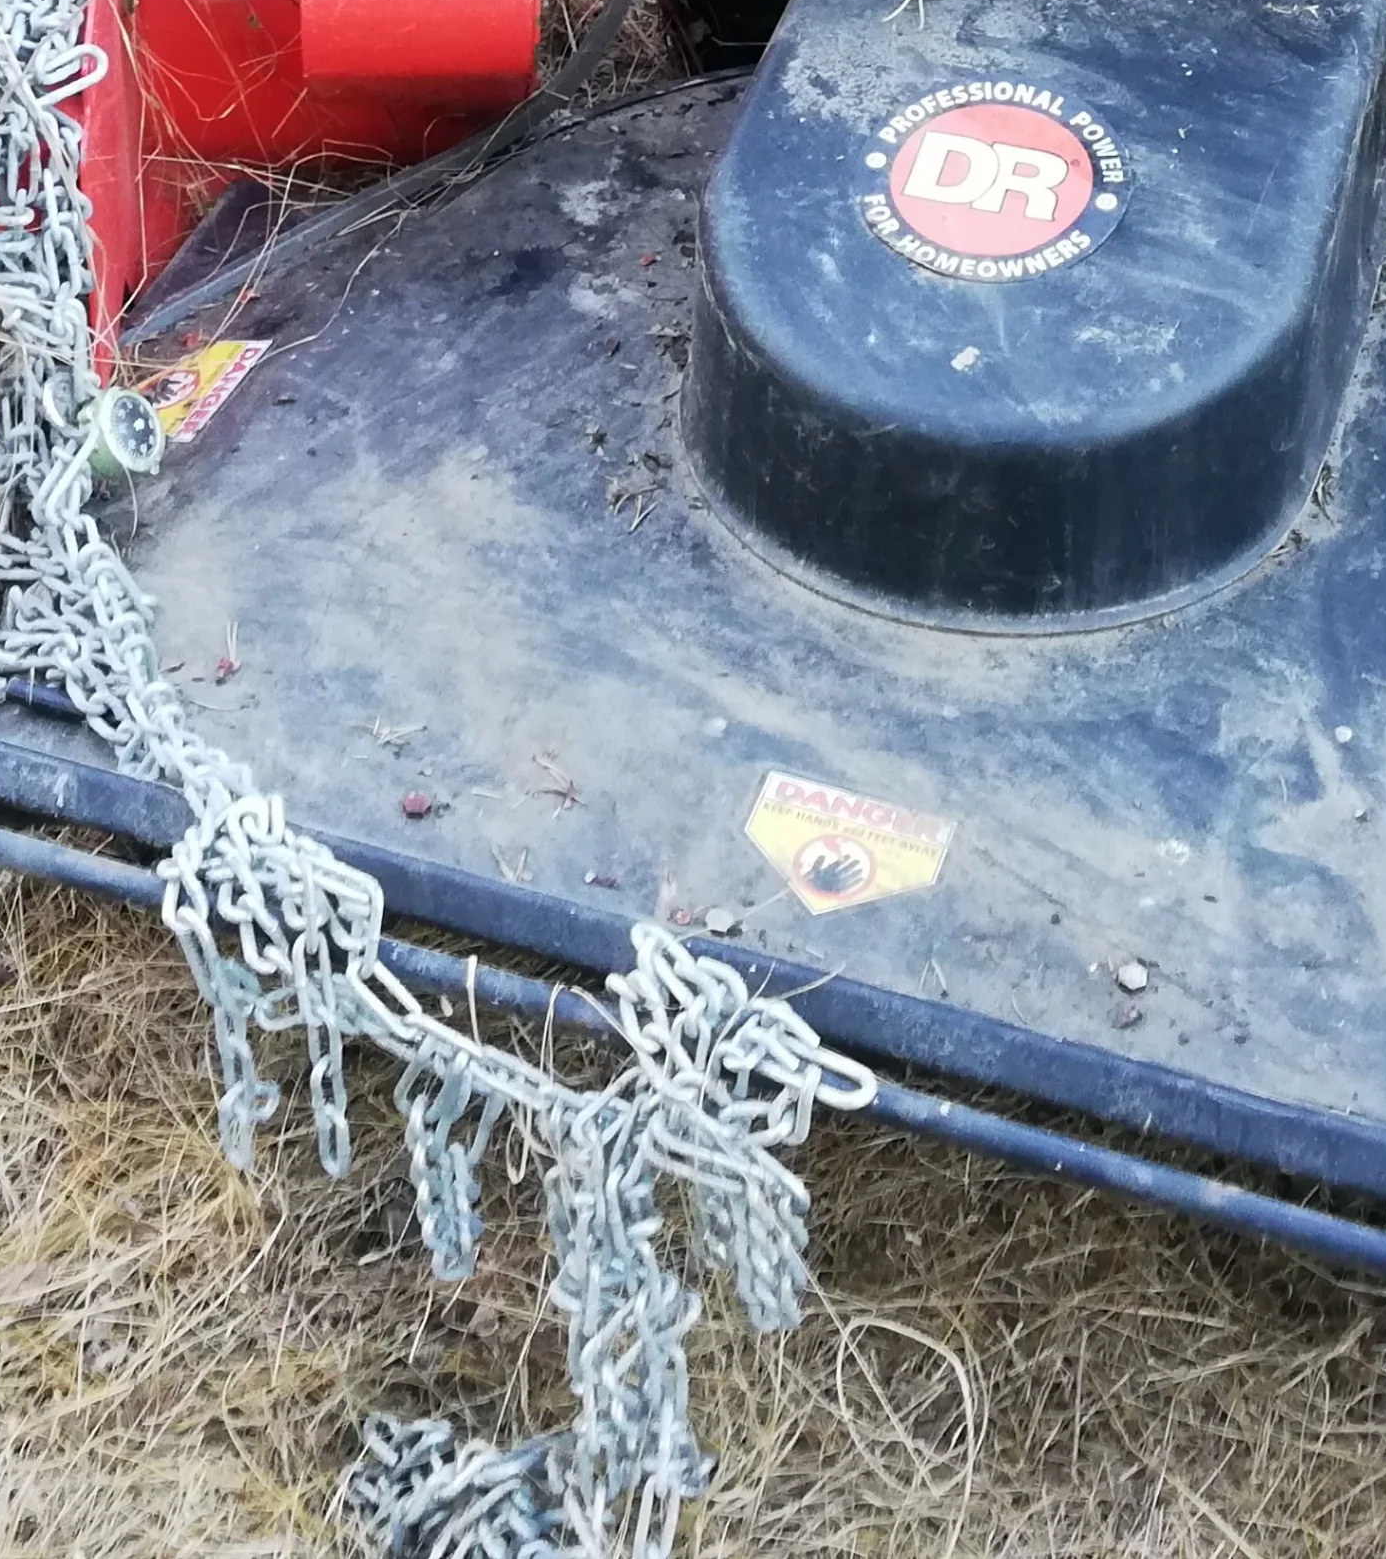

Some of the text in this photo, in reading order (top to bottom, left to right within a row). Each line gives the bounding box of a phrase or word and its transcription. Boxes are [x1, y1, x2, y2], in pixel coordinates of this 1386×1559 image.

[878, 81, 1124, 183] PROFESSIONAL POWER
[901, 131, 1070, 223] DR
[863, 193, 1092, 279] FOR HOMEOWNERS
[898, 841, 938, 859] AWAY
